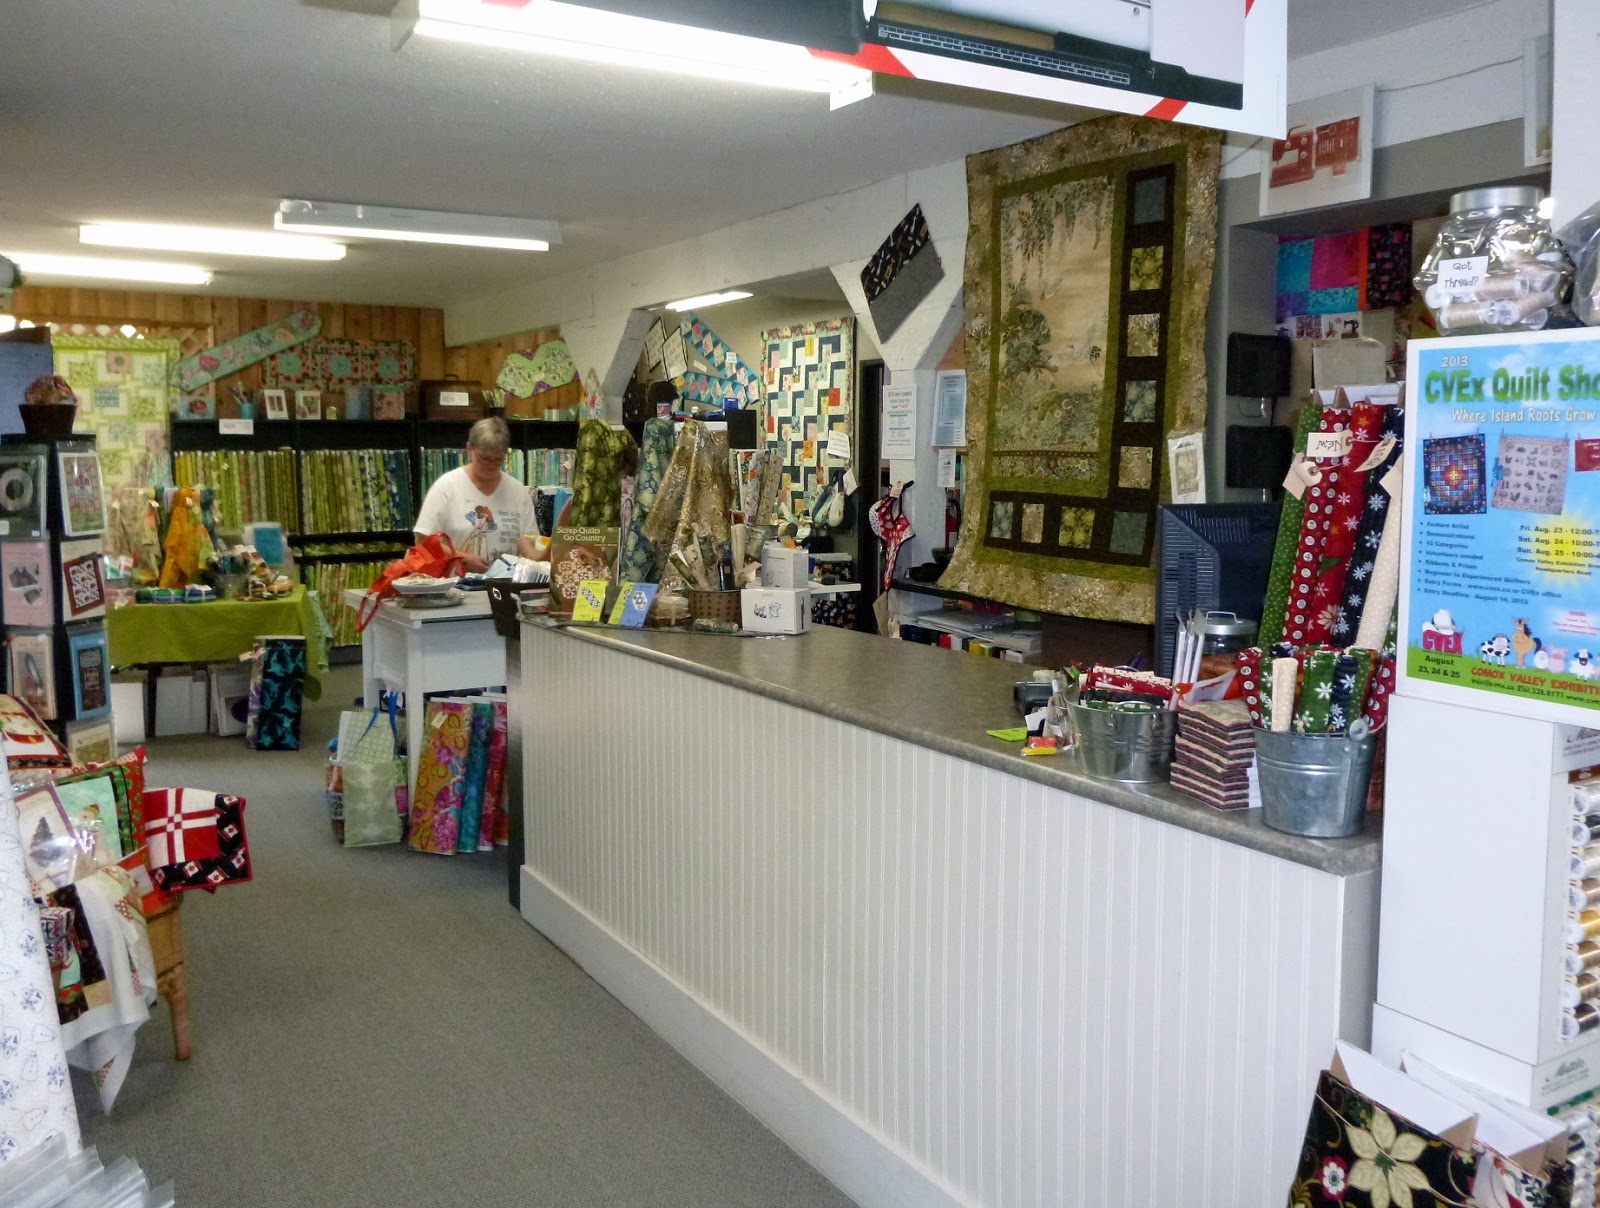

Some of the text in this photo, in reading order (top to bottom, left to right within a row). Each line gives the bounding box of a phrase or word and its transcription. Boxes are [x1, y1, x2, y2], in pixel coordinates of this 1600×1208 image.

[1453, 261, 1472, 271] Got
[1444, 276, 1479, 288] Thread?
[1441, 356, 1469, 368] 2013
[1425, 369, 1486, 404] CVEx
[1493, 367, 1550, 404] Quilt
[1452, 405, 1596, 422] Where Island Roots Grow
[557, 526, 601, 535] Scrap Quilts
[1426, 531, 1475, 539] Demonstrations
[575, 534, 607, 543] Country
[1535, 537, 1552, 545] Aug.
[1435, 541, 1468, 549] Categories
[1426, 550, 1458, 558] Volunteers
[1536, 548, 1552, 556] Aug.
[1462, 573, 1502, 581] Experienced
[1424, 578, 1440, 586] Entry
[1442, 590, 1469, 598] Deadline
[1475, 593, 1498, 601] August
[1425, 655, 1454, 666] August
[1418, 665, 1429, 674] 23,
[1431, 667, 1441, 675] 24
[1451, 670, 1460, 679] 25
[1471, 667, 1505, 679] COMOX
[1510, 672, 1547, 688] VALLEY
